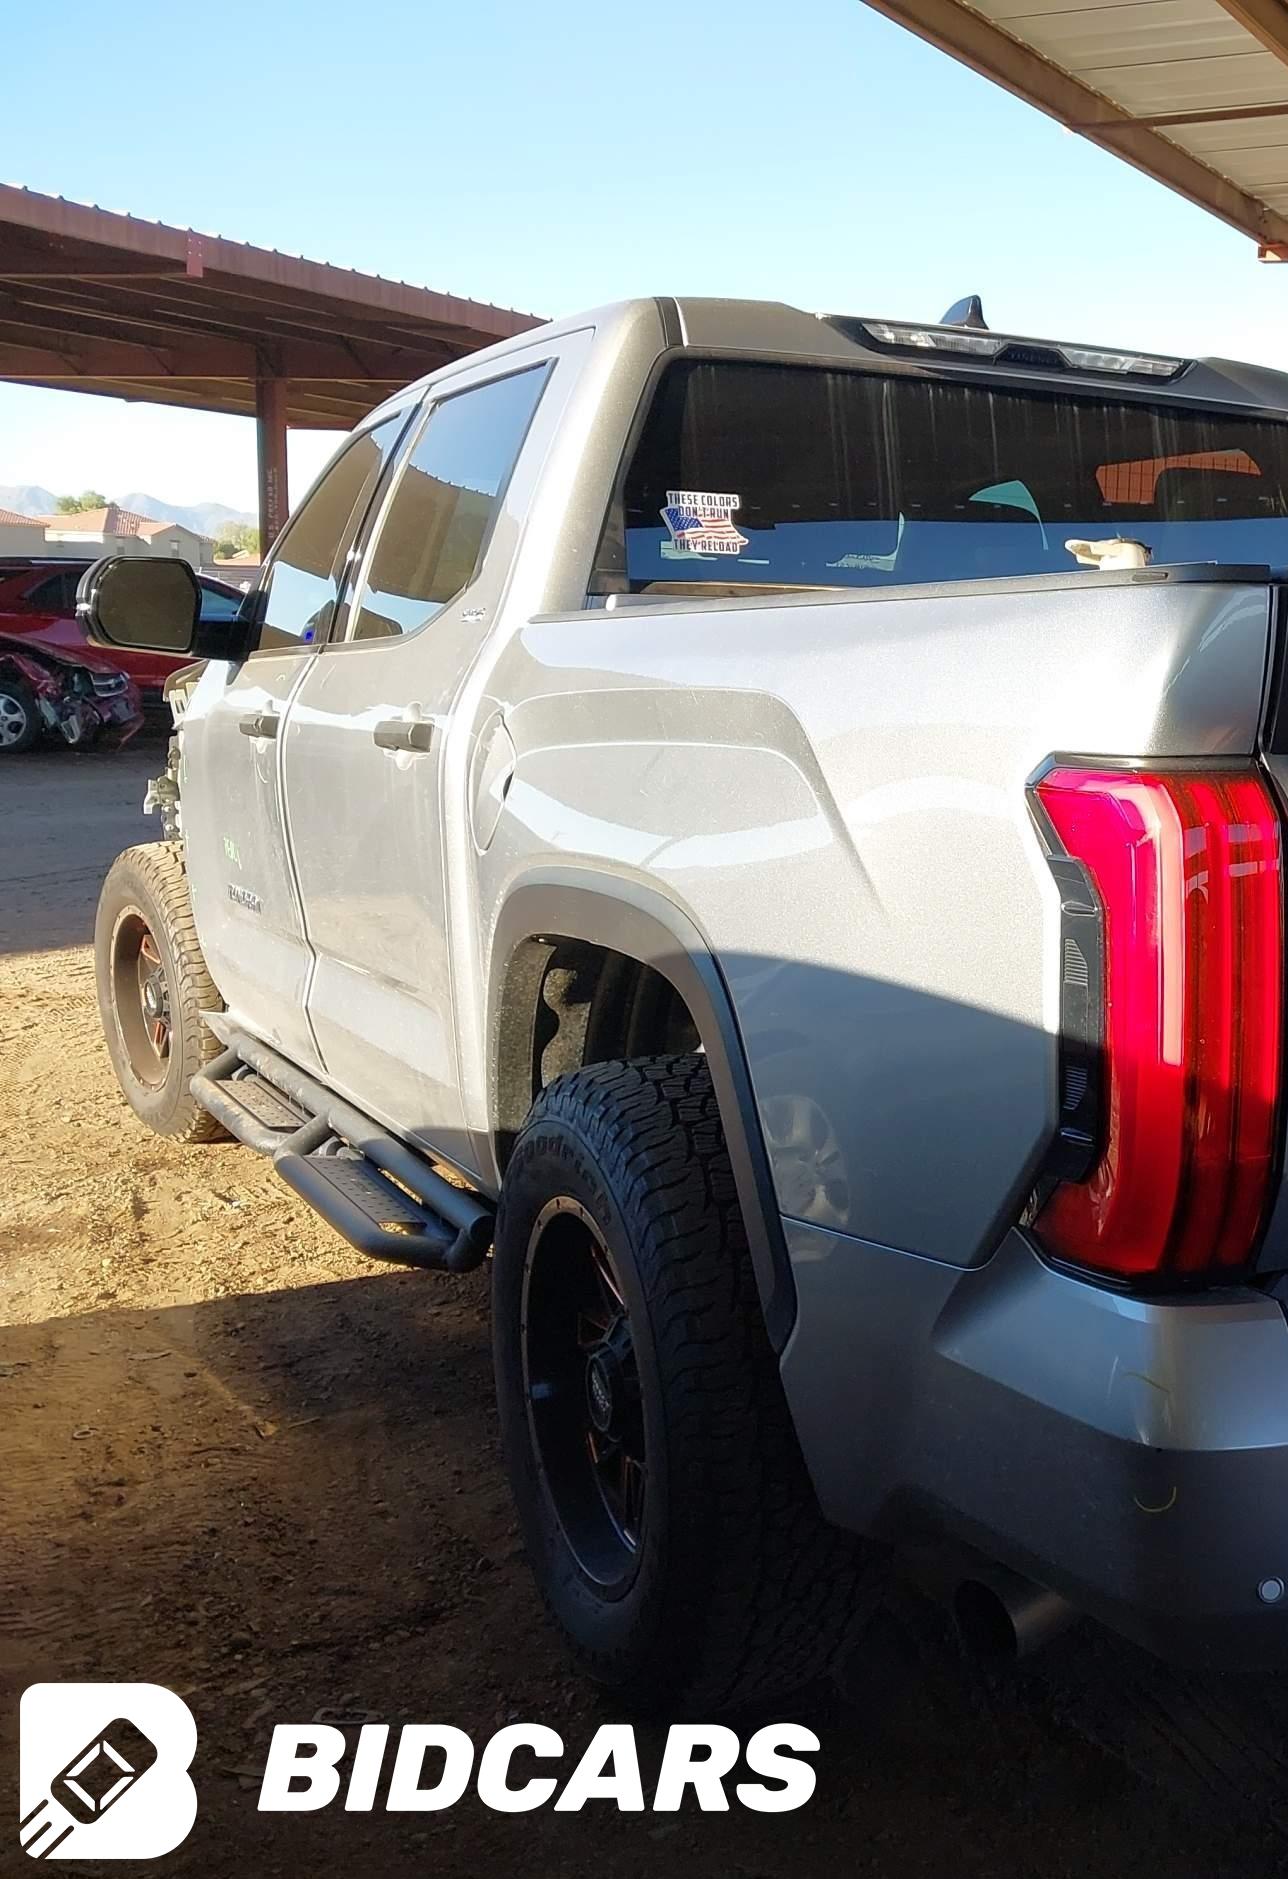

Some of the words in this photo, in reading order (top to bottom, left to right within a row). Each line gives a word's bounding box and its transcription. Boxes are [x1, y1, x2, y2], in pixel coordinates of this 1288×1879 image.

[667, 493, 699, 506] THESE
[701, 494, 738, 508] COLORS
[710, 508, 730, 519] RUN
[674, 540, 698, 552] THEY
[701, 540, 738, 553] RELOAD
